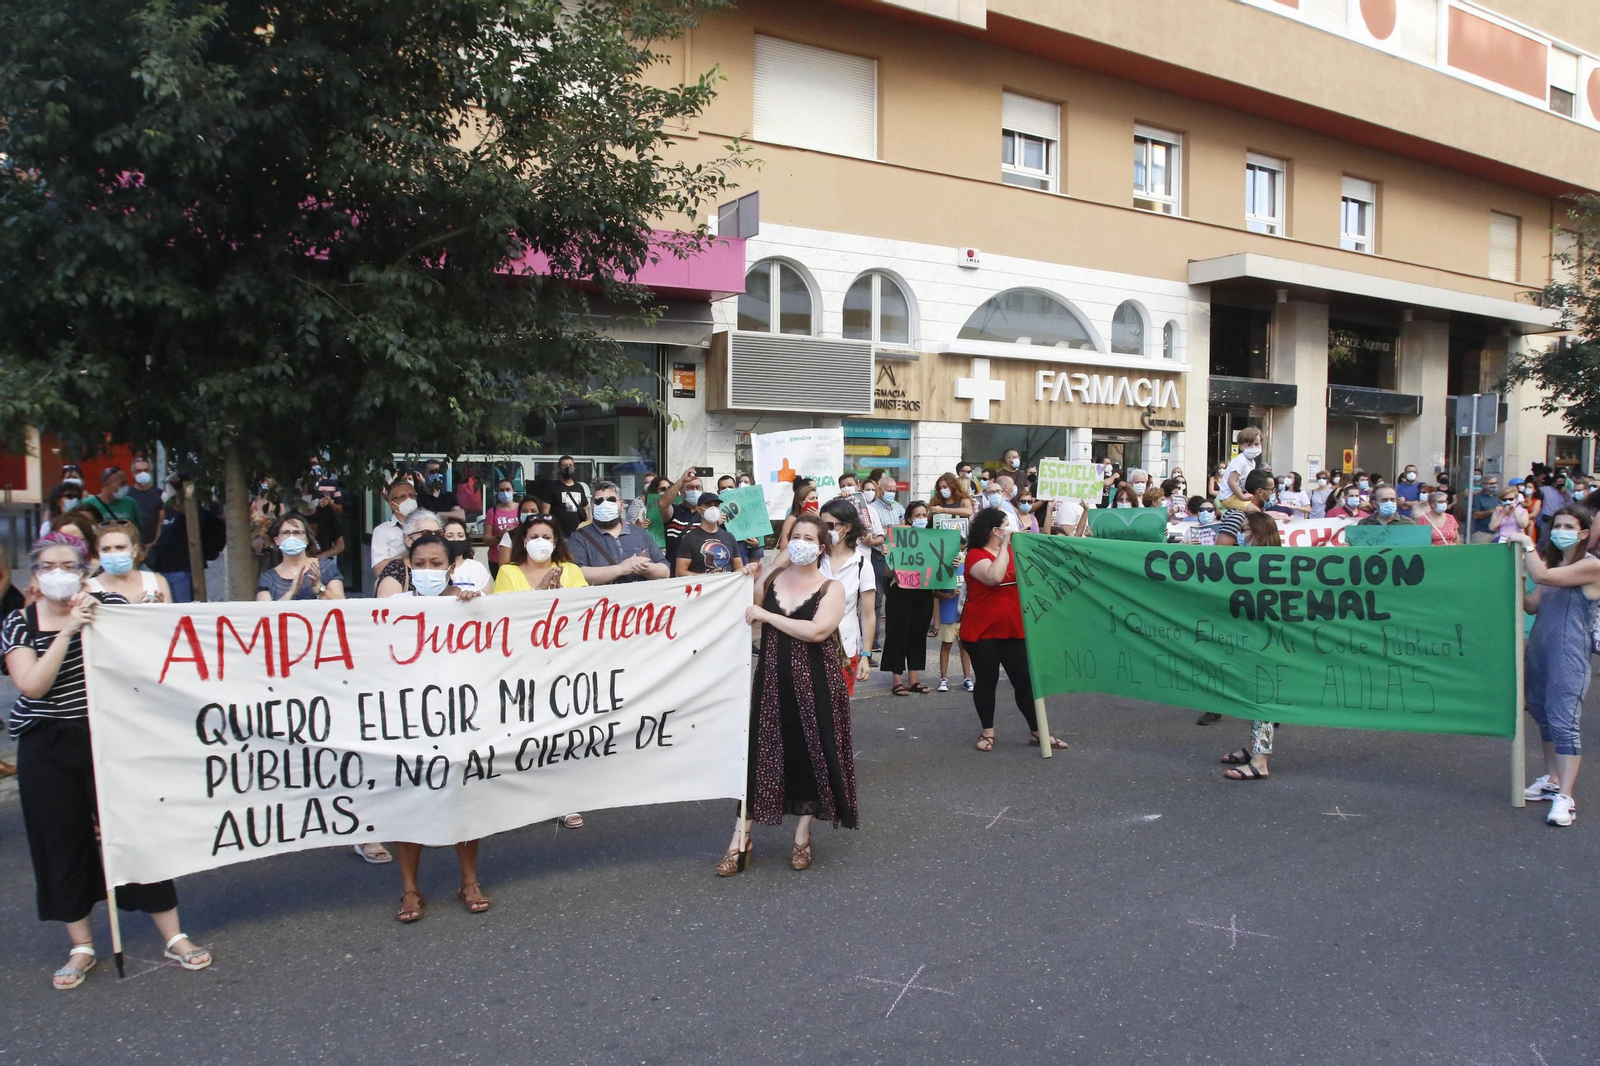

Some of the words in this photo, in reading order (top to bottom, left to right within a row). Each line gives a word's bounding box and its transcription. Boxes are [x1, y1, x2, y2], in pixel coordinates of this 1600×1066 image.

[1035, 369, 1181, 409] FARMACIA
[1038, 480, 1097, 499] PUBLICA
[1040, 461, 1096, 481] ESCUELA
[721, 502, 739, 523] NO
[888, 552, 896, 569] A
[900, 551, 925, 567] LOS
[1015, 536, 1080, 588] AMPA
[1144, 548, 1425, 586] CONCEPCIÓN
[1229, 589, 1392, 622] ARENAL
[158, 608, 355, 684] AMPA
[530, 598, 569, 650] de
[1194, 619, 1250, 656] Elegir
[1312, 625, 1369, 655] Cole
[1064, 650, 1097, 680] NO
[1117, 651, 1142, 685] AL
[1153, 653, 1231, 699] CIERRE
[1255, 664, 1292, 706] DE
[1320, 664, 1436, 714] AULAS
[195, 695, 332, 746] QUIERO
[358, 684, 481, 742] ELEGIR
[499, 678, 536, 724] MI
[550, 668, 625, 719] COLE
[205, 743, 376, 799] PÚBLICO,
[395, 753, 451, 791] NO
[462, 744, 503, 786] AL
[514, 721, 621, 773] CIERRE
[635, 709, 677, 750] DE
[211, 795, 375, 857] AULAS.
